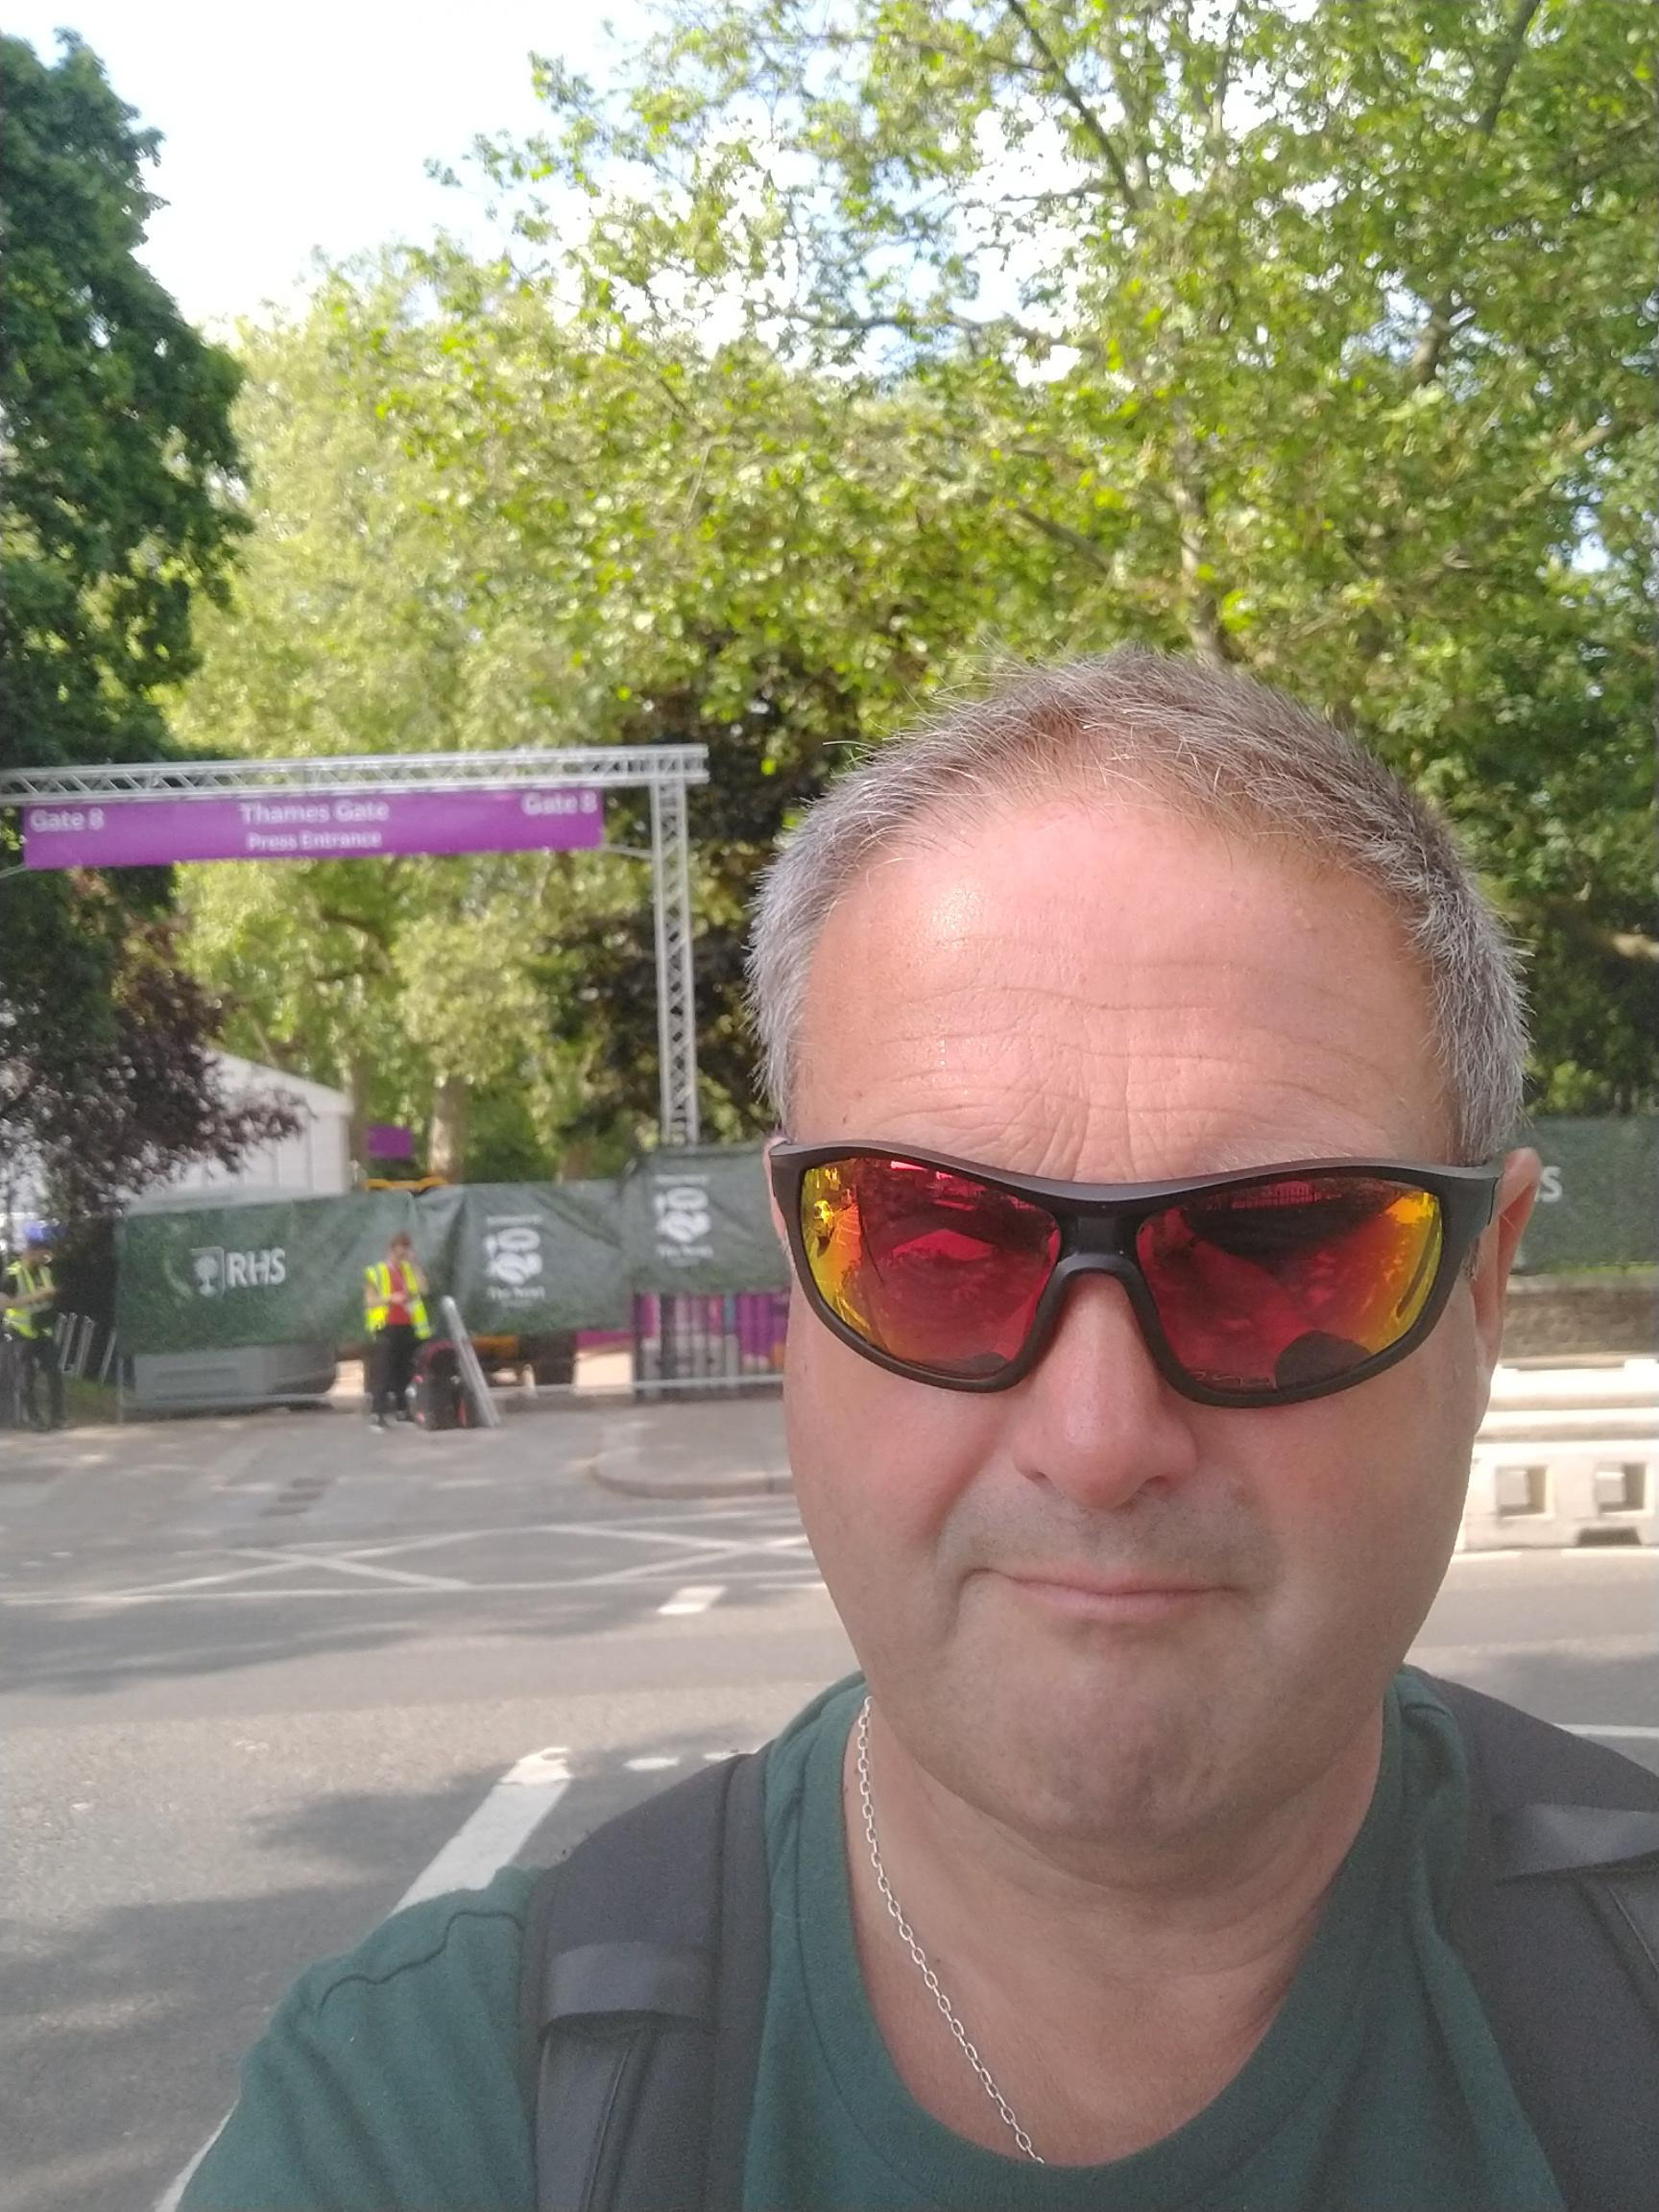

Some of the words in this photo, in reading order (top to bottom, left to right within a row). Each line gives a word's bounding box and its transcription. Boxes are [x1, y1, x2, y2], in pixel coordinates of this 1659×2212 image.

[240, 801, 330, 825] Thames
[334, 799, 390, 822] Gate
[521, 791, 577, 815] Gate
[30, 809, 85, 833] Gate
[246, 831, 298, 852] Press
[299, 830, 383, 851] Entrance
[227, 1247, 286, 1287] RHS
